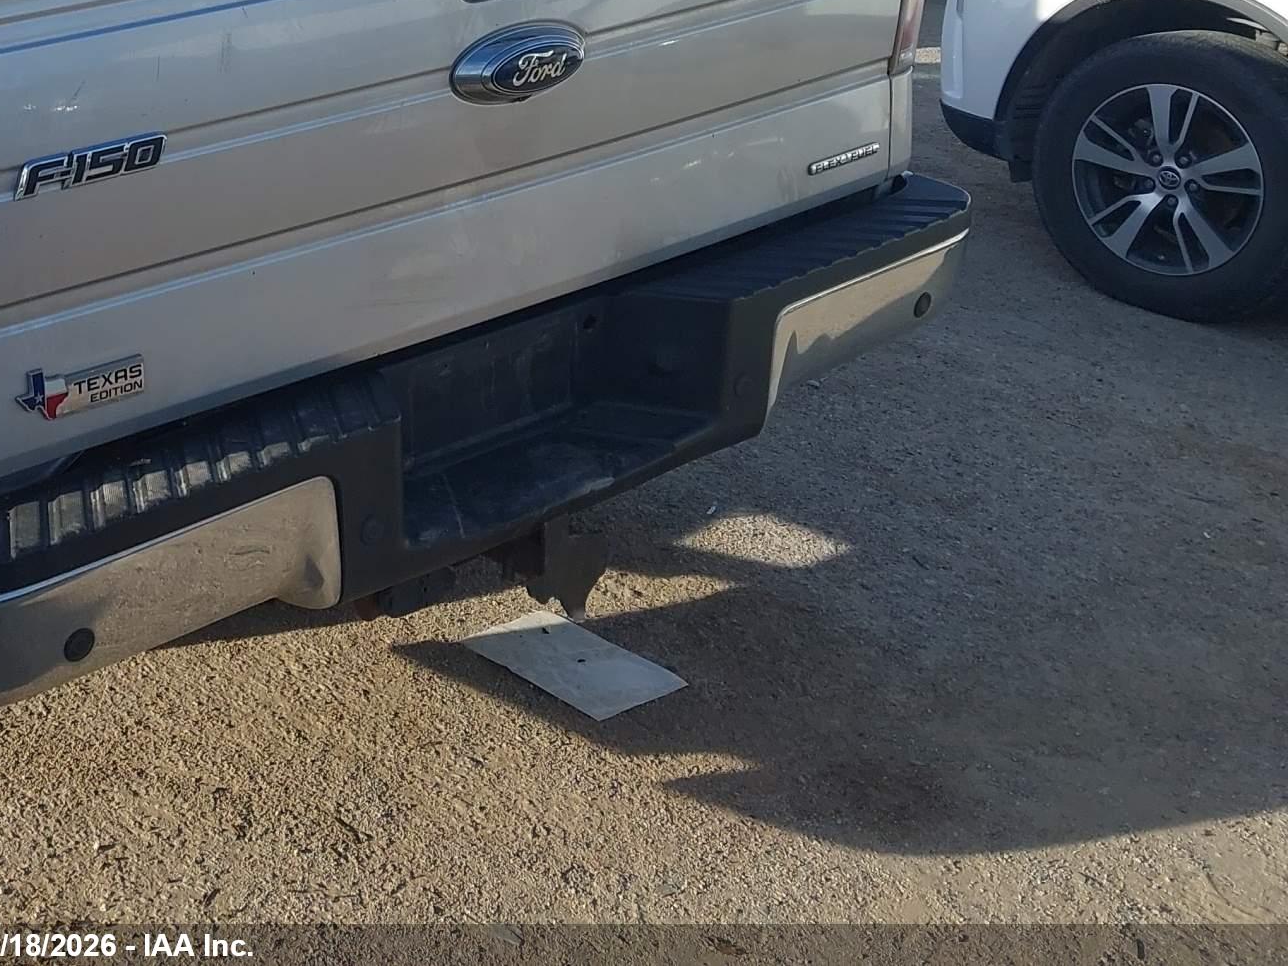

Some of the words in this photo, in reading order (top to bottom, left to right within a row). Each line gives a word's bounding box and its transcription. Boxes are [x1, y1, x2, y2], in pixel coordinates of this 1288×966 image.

[512, 50, 567, 87] Ford
[73, 364, 142, 395] TEXAS
[90, 379, 143, 403] EDITION
